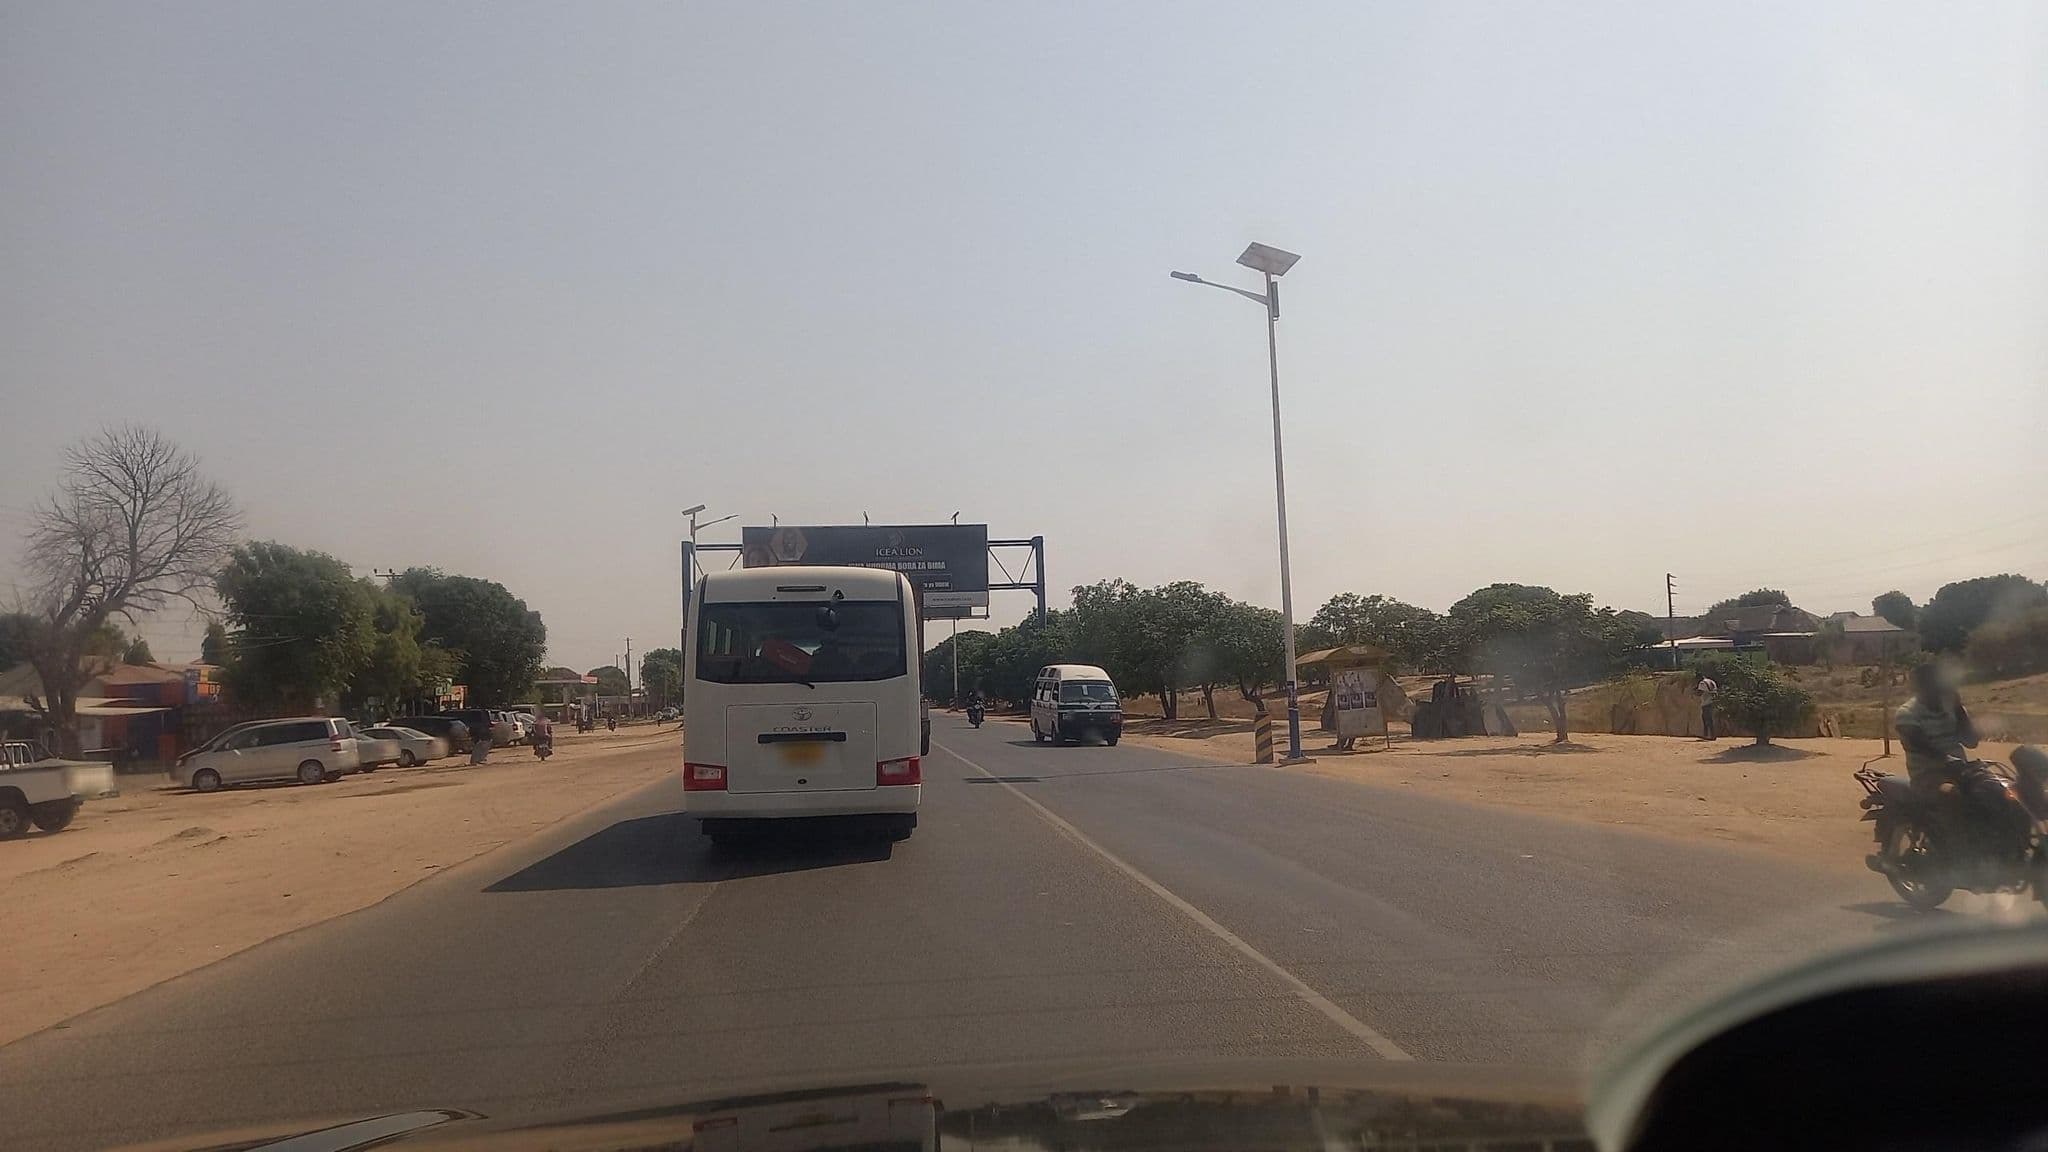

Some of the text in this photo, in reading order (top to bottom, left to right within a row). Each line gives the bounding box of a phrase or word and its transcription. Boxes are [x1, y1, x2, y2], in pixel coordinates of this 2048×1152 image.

[876, 547, 923, 556] ICEA LION
[918, 561, 926, 570] ZA
